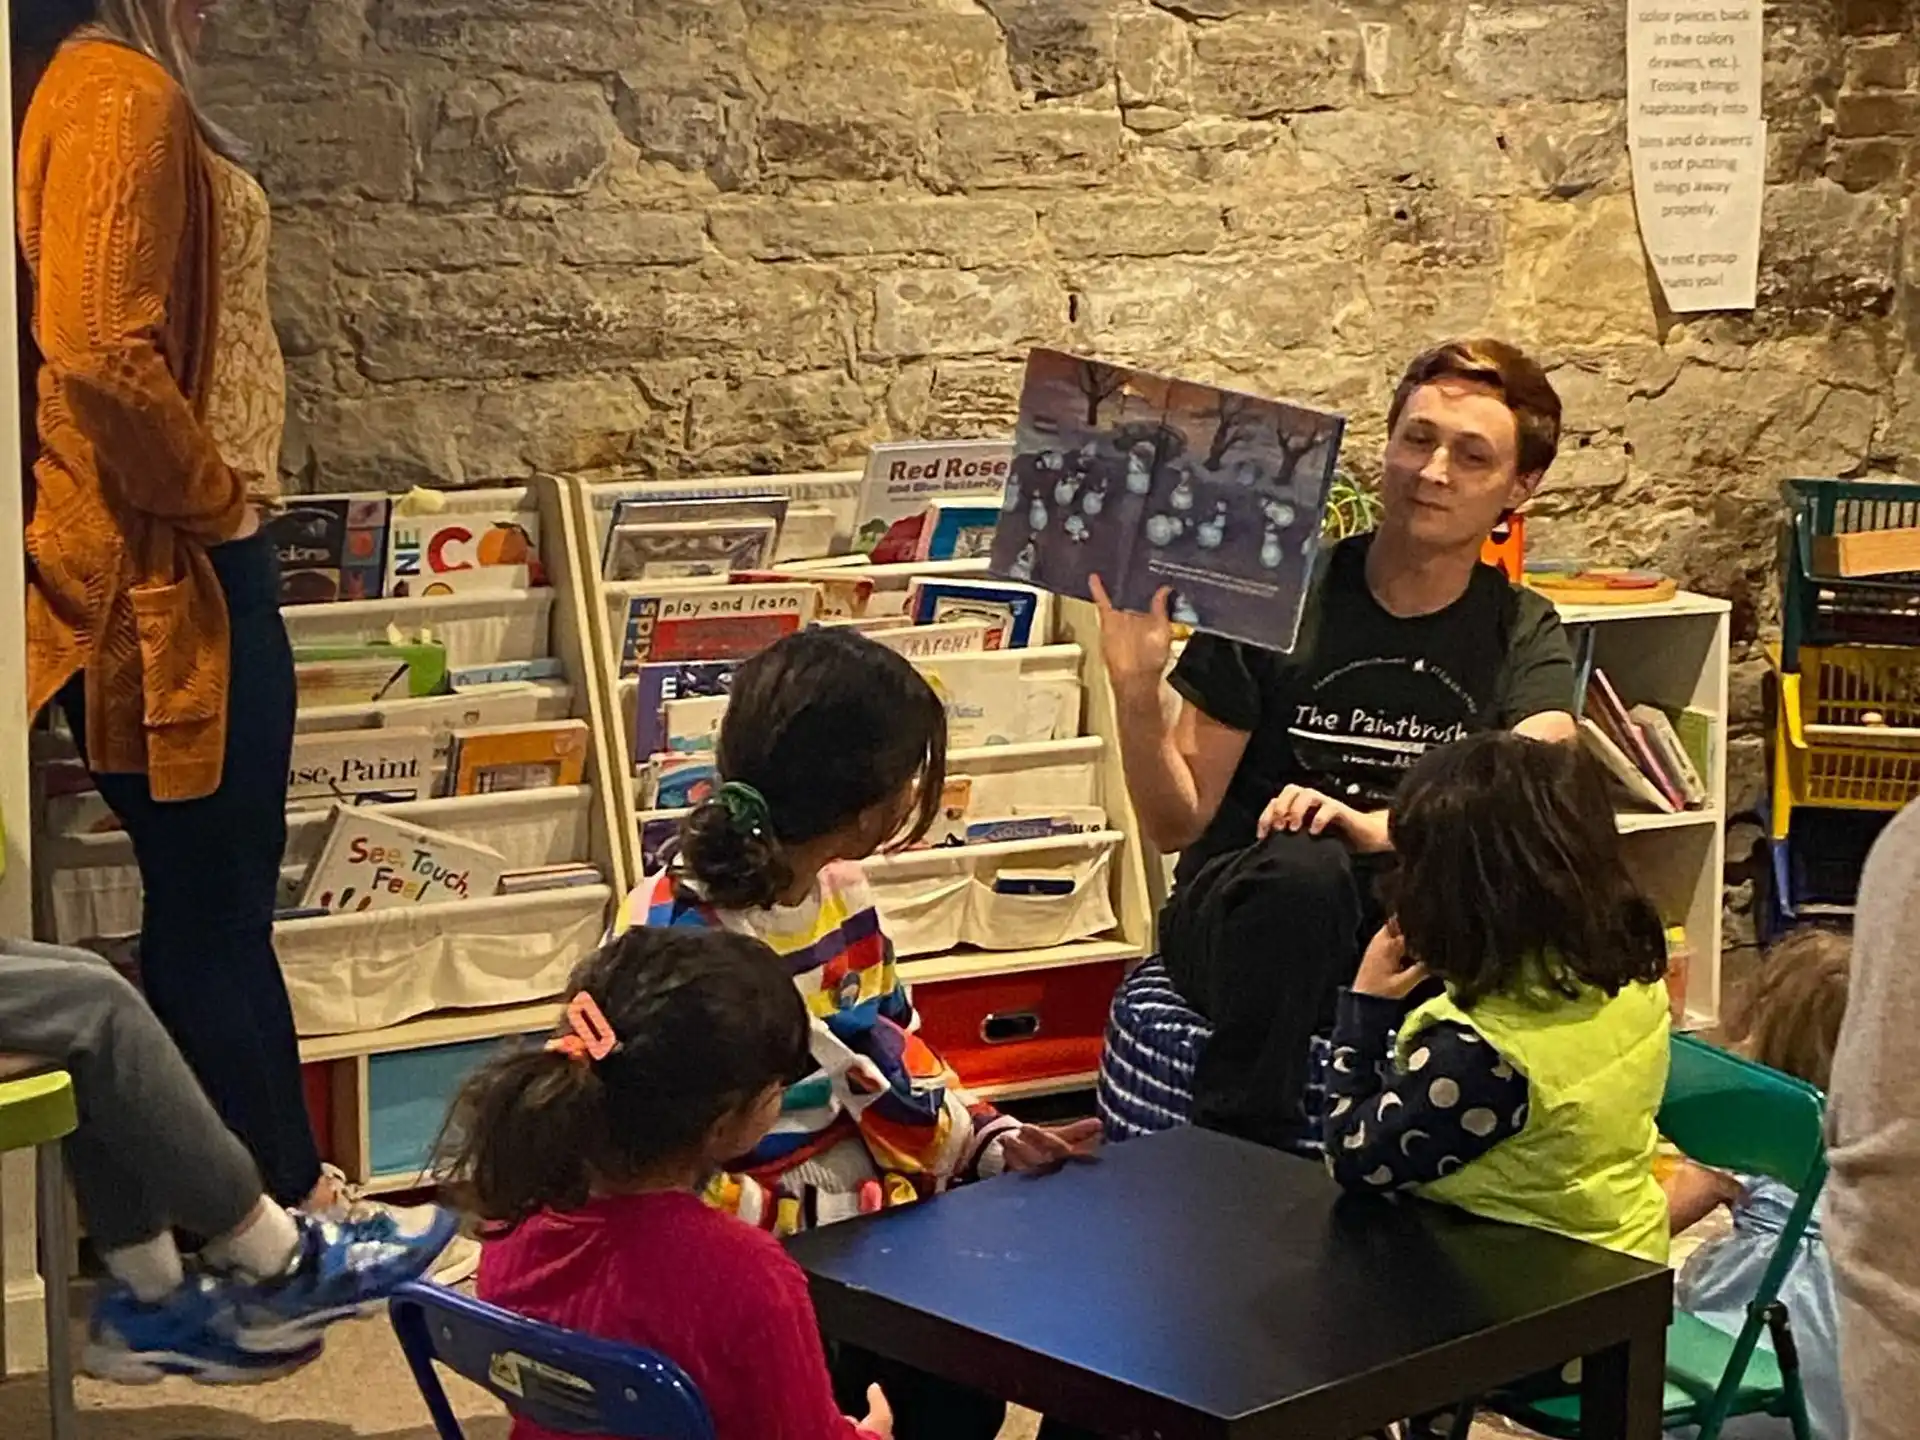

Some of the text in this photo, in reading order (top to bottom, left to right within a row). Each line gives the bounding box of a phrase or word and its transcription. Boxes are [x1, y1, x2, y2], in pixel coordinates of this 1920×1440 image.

[1670, 32, 1692, 45] the
[1695, 32, 1735, 45] colors
[1700, 79, 1740, 94] things
[1666, 134, 1692, 147] and
[1694, 132, 1753, 147] drawers
[1661, 157, 1683, 171] not
[1653, 180, 1733, 196] things away
[1698, 253, 1738, 267] group
[889, 456, 1008, 481] Red Rose
[663, 594, 799, 618] play and learn
[1294, 704, 1469, 743] The Paintbrush
[340, 756, 419, 783] Paint
[371, 865, 432, 902] Feel
